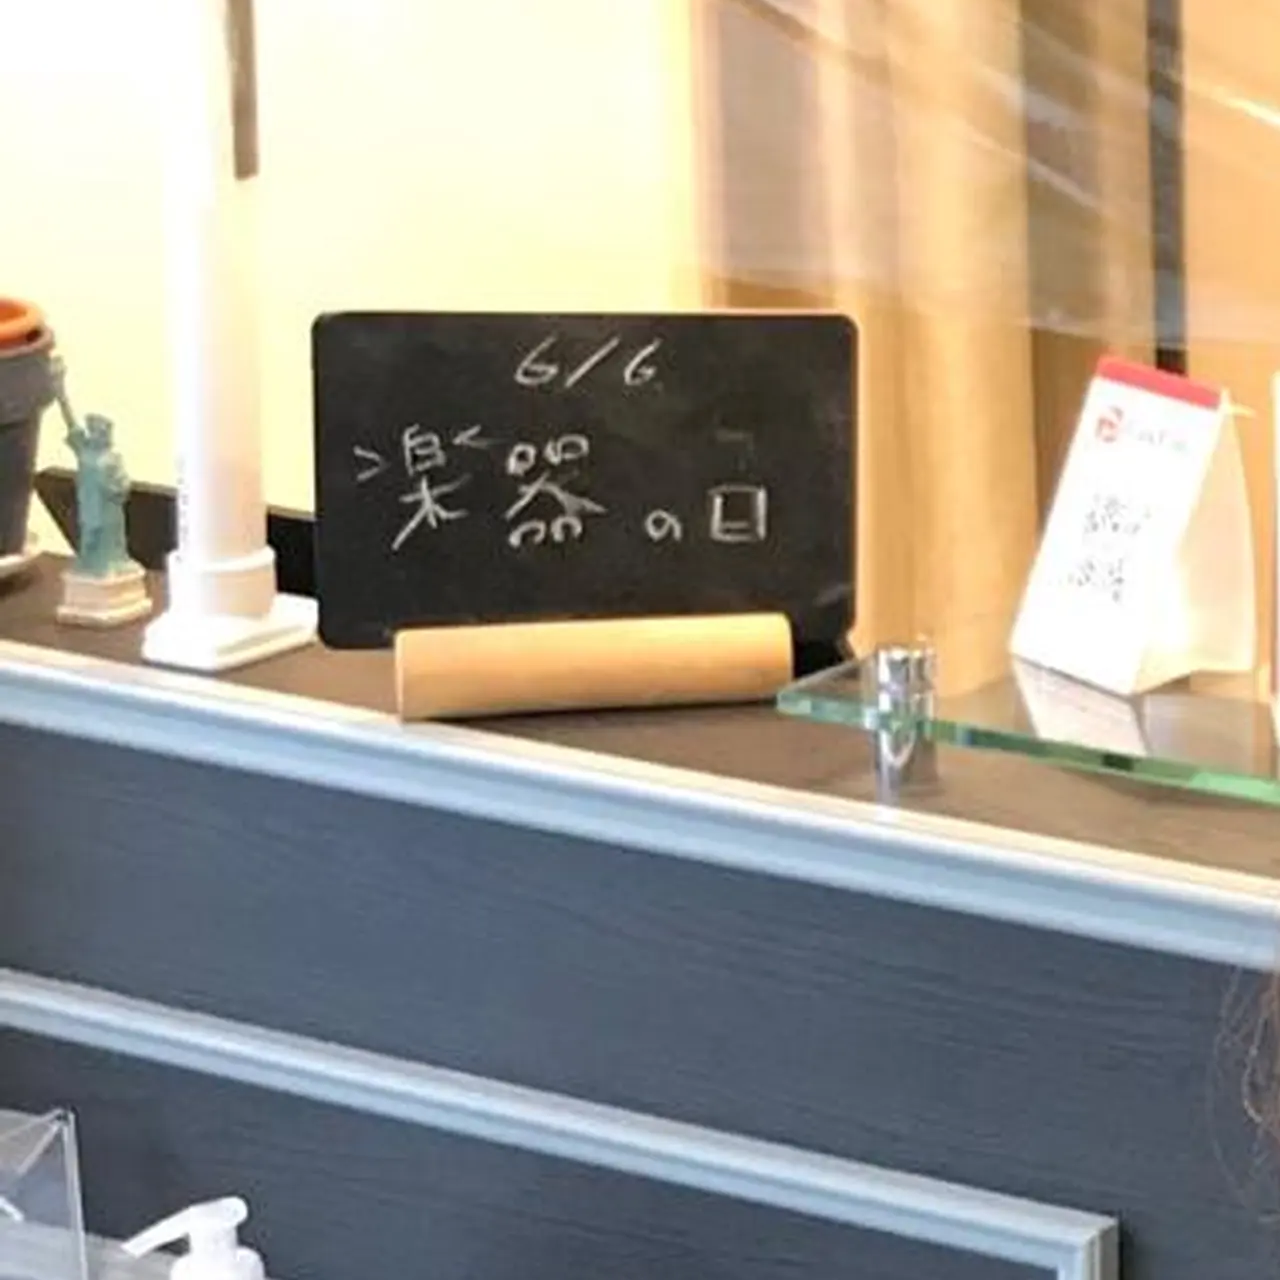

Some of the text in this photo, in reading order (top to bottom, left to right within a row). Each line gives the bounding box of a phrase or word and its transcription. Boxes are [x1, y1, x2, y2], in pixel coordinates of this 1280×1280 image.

[514, 333, 663, 388] 6/6
[352, 422, 769, 550] 楽器の日
